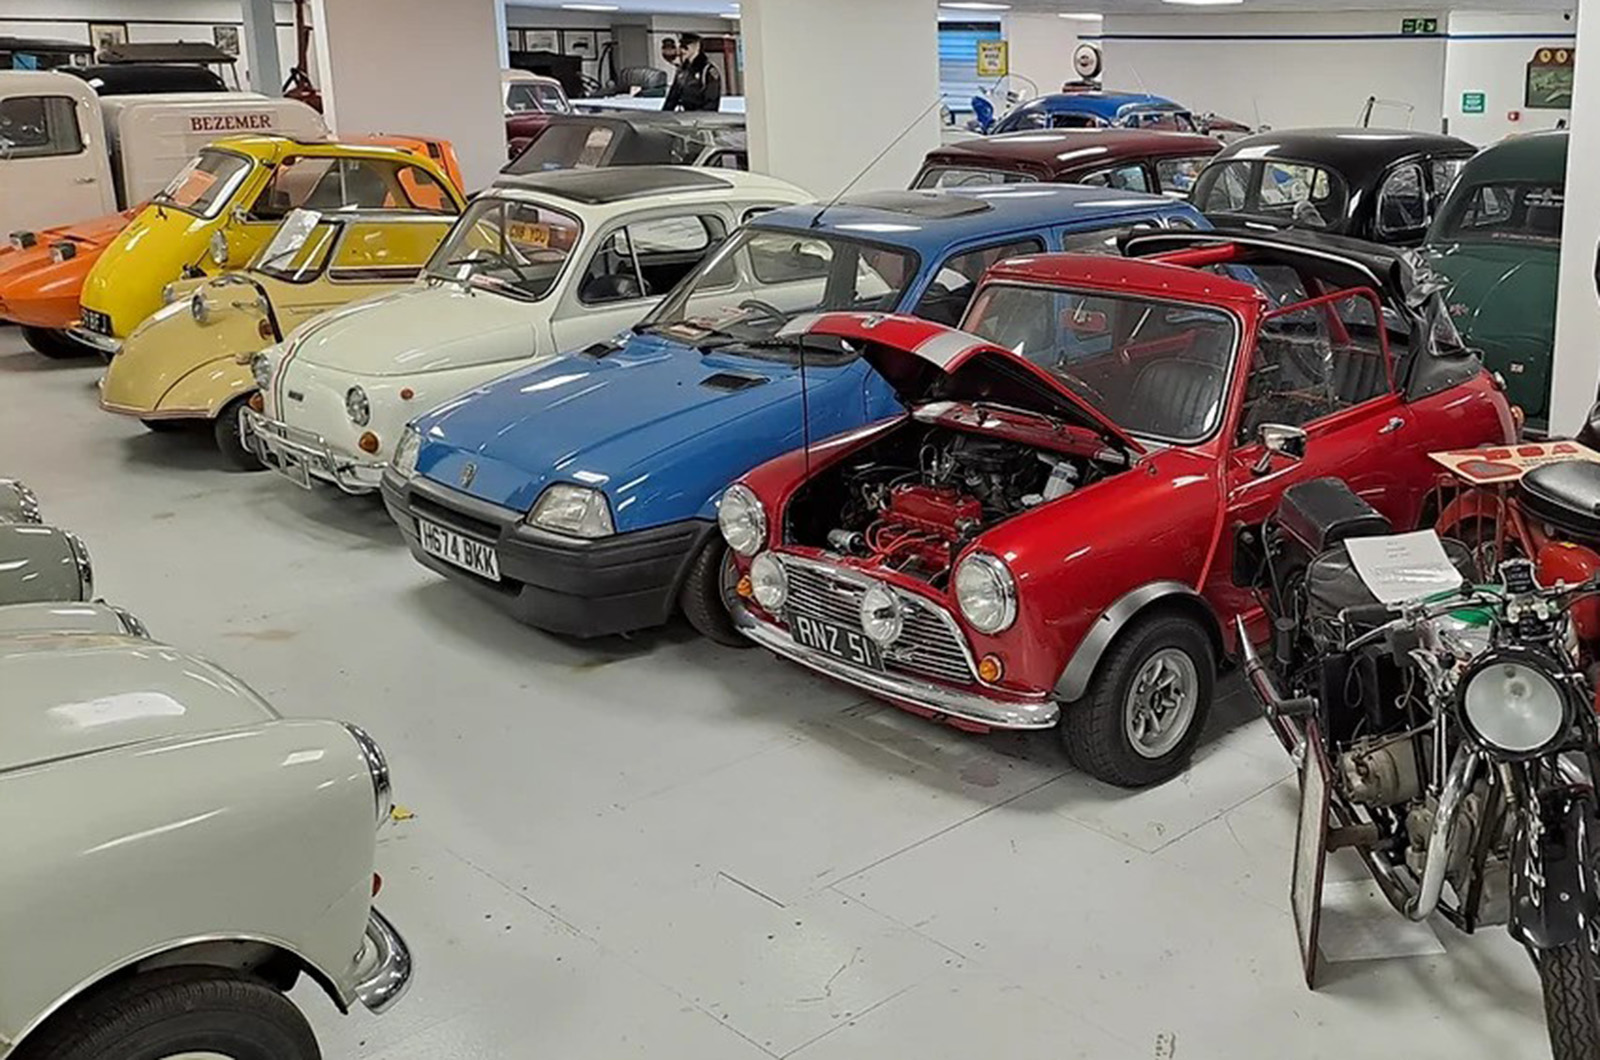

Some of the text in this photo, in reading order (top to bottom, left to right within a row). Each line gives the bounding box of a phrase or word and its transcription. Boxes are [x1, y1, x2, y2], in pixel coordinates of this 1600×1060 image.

[190, 114, 272, 131] BEZEMER
[421, 521, 496, 577] H674 BKK
[796, 615, 843, 656] RNZ
